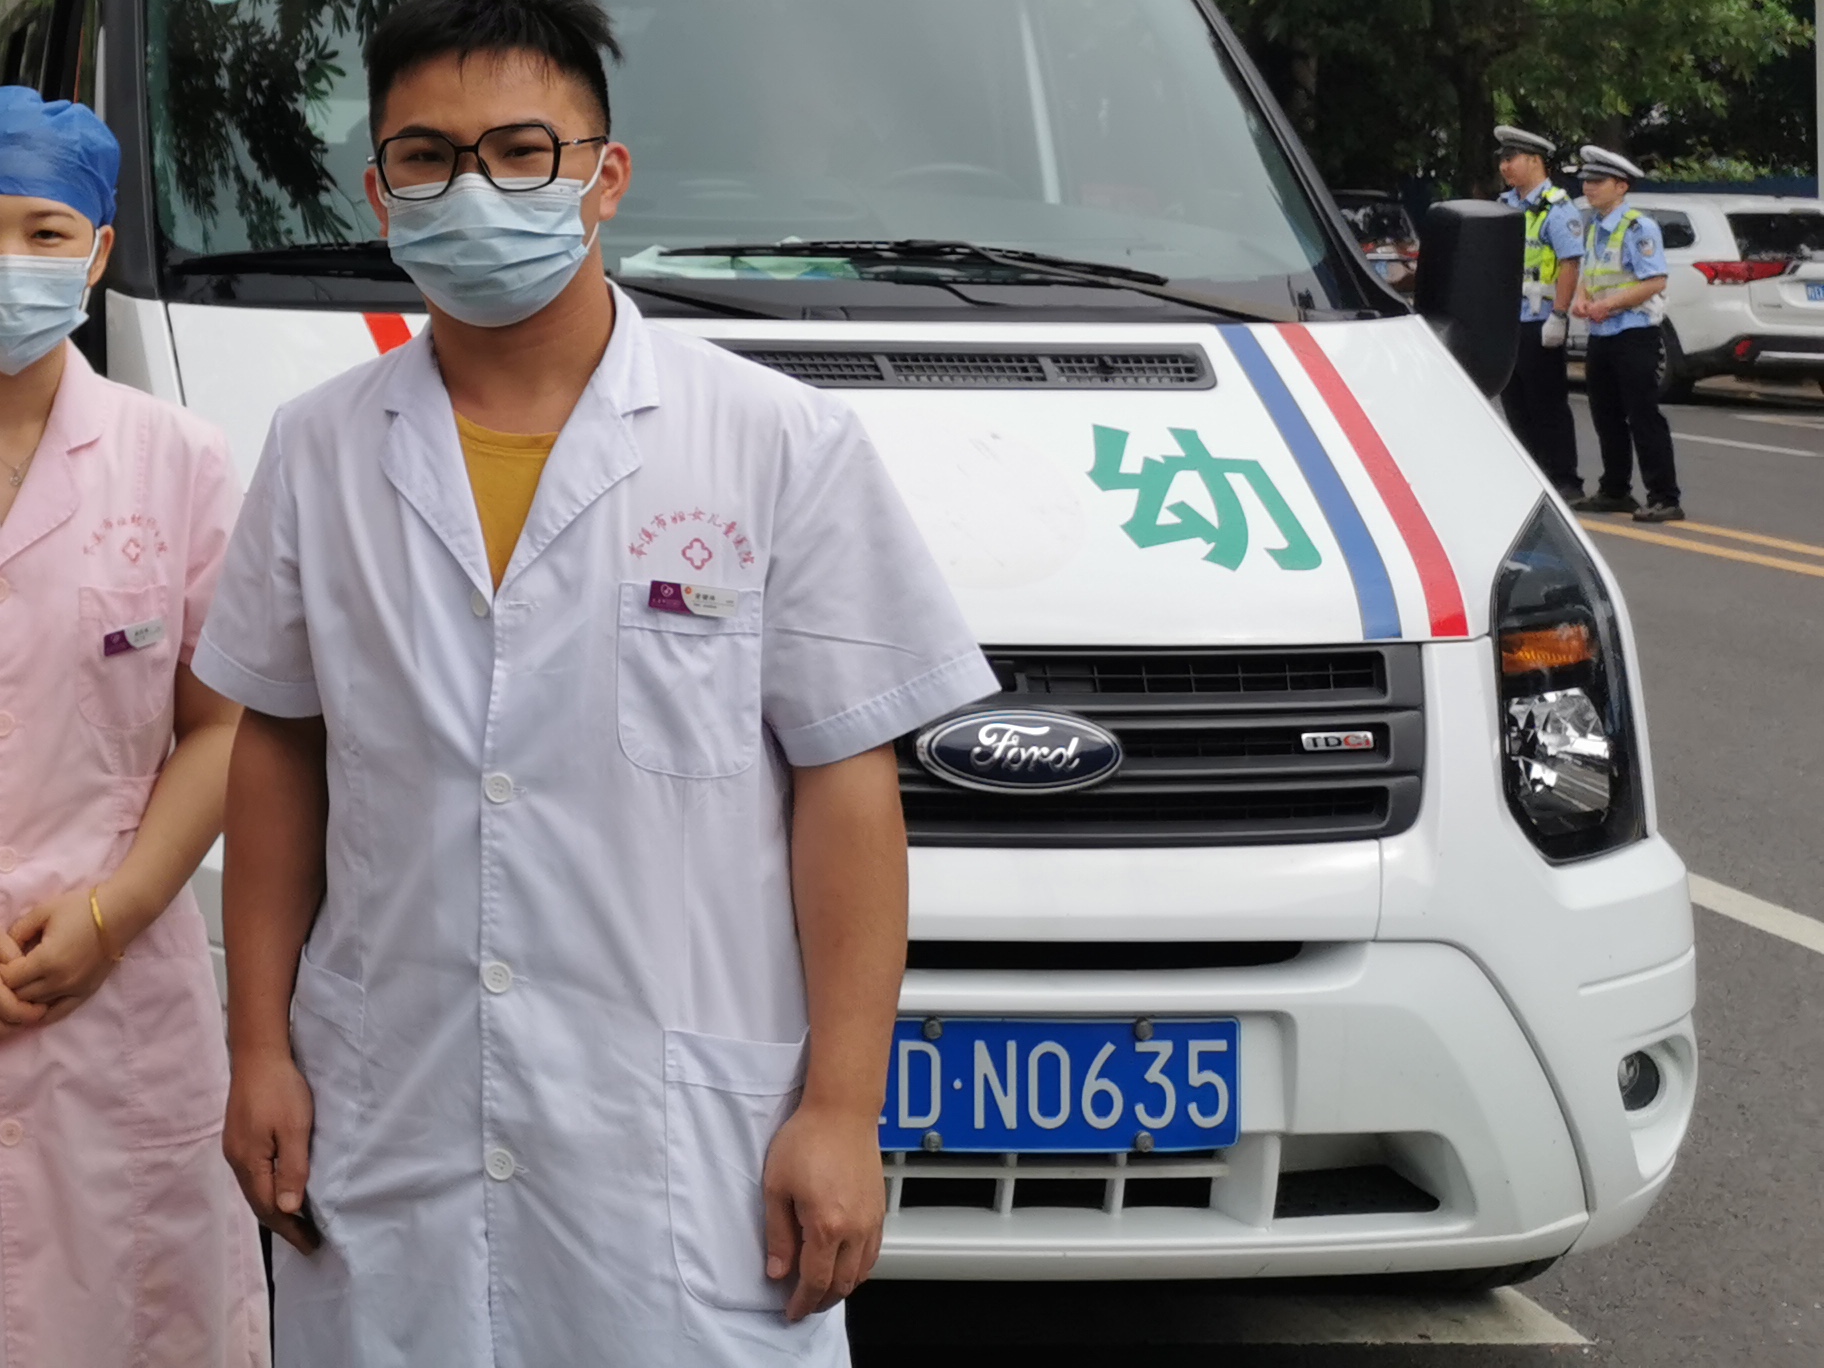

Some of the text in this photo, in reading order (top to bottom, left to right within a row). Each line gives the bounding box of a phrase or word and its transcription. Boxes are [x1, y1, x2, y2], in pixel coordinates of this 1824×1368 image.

[1087, 425, 1322, 571] 幼
[971, 722, 1081, 771] Ford
[1308, 734, 1371, 750] TDCi
[879, 1040, 1229, 1129] D·N0635
